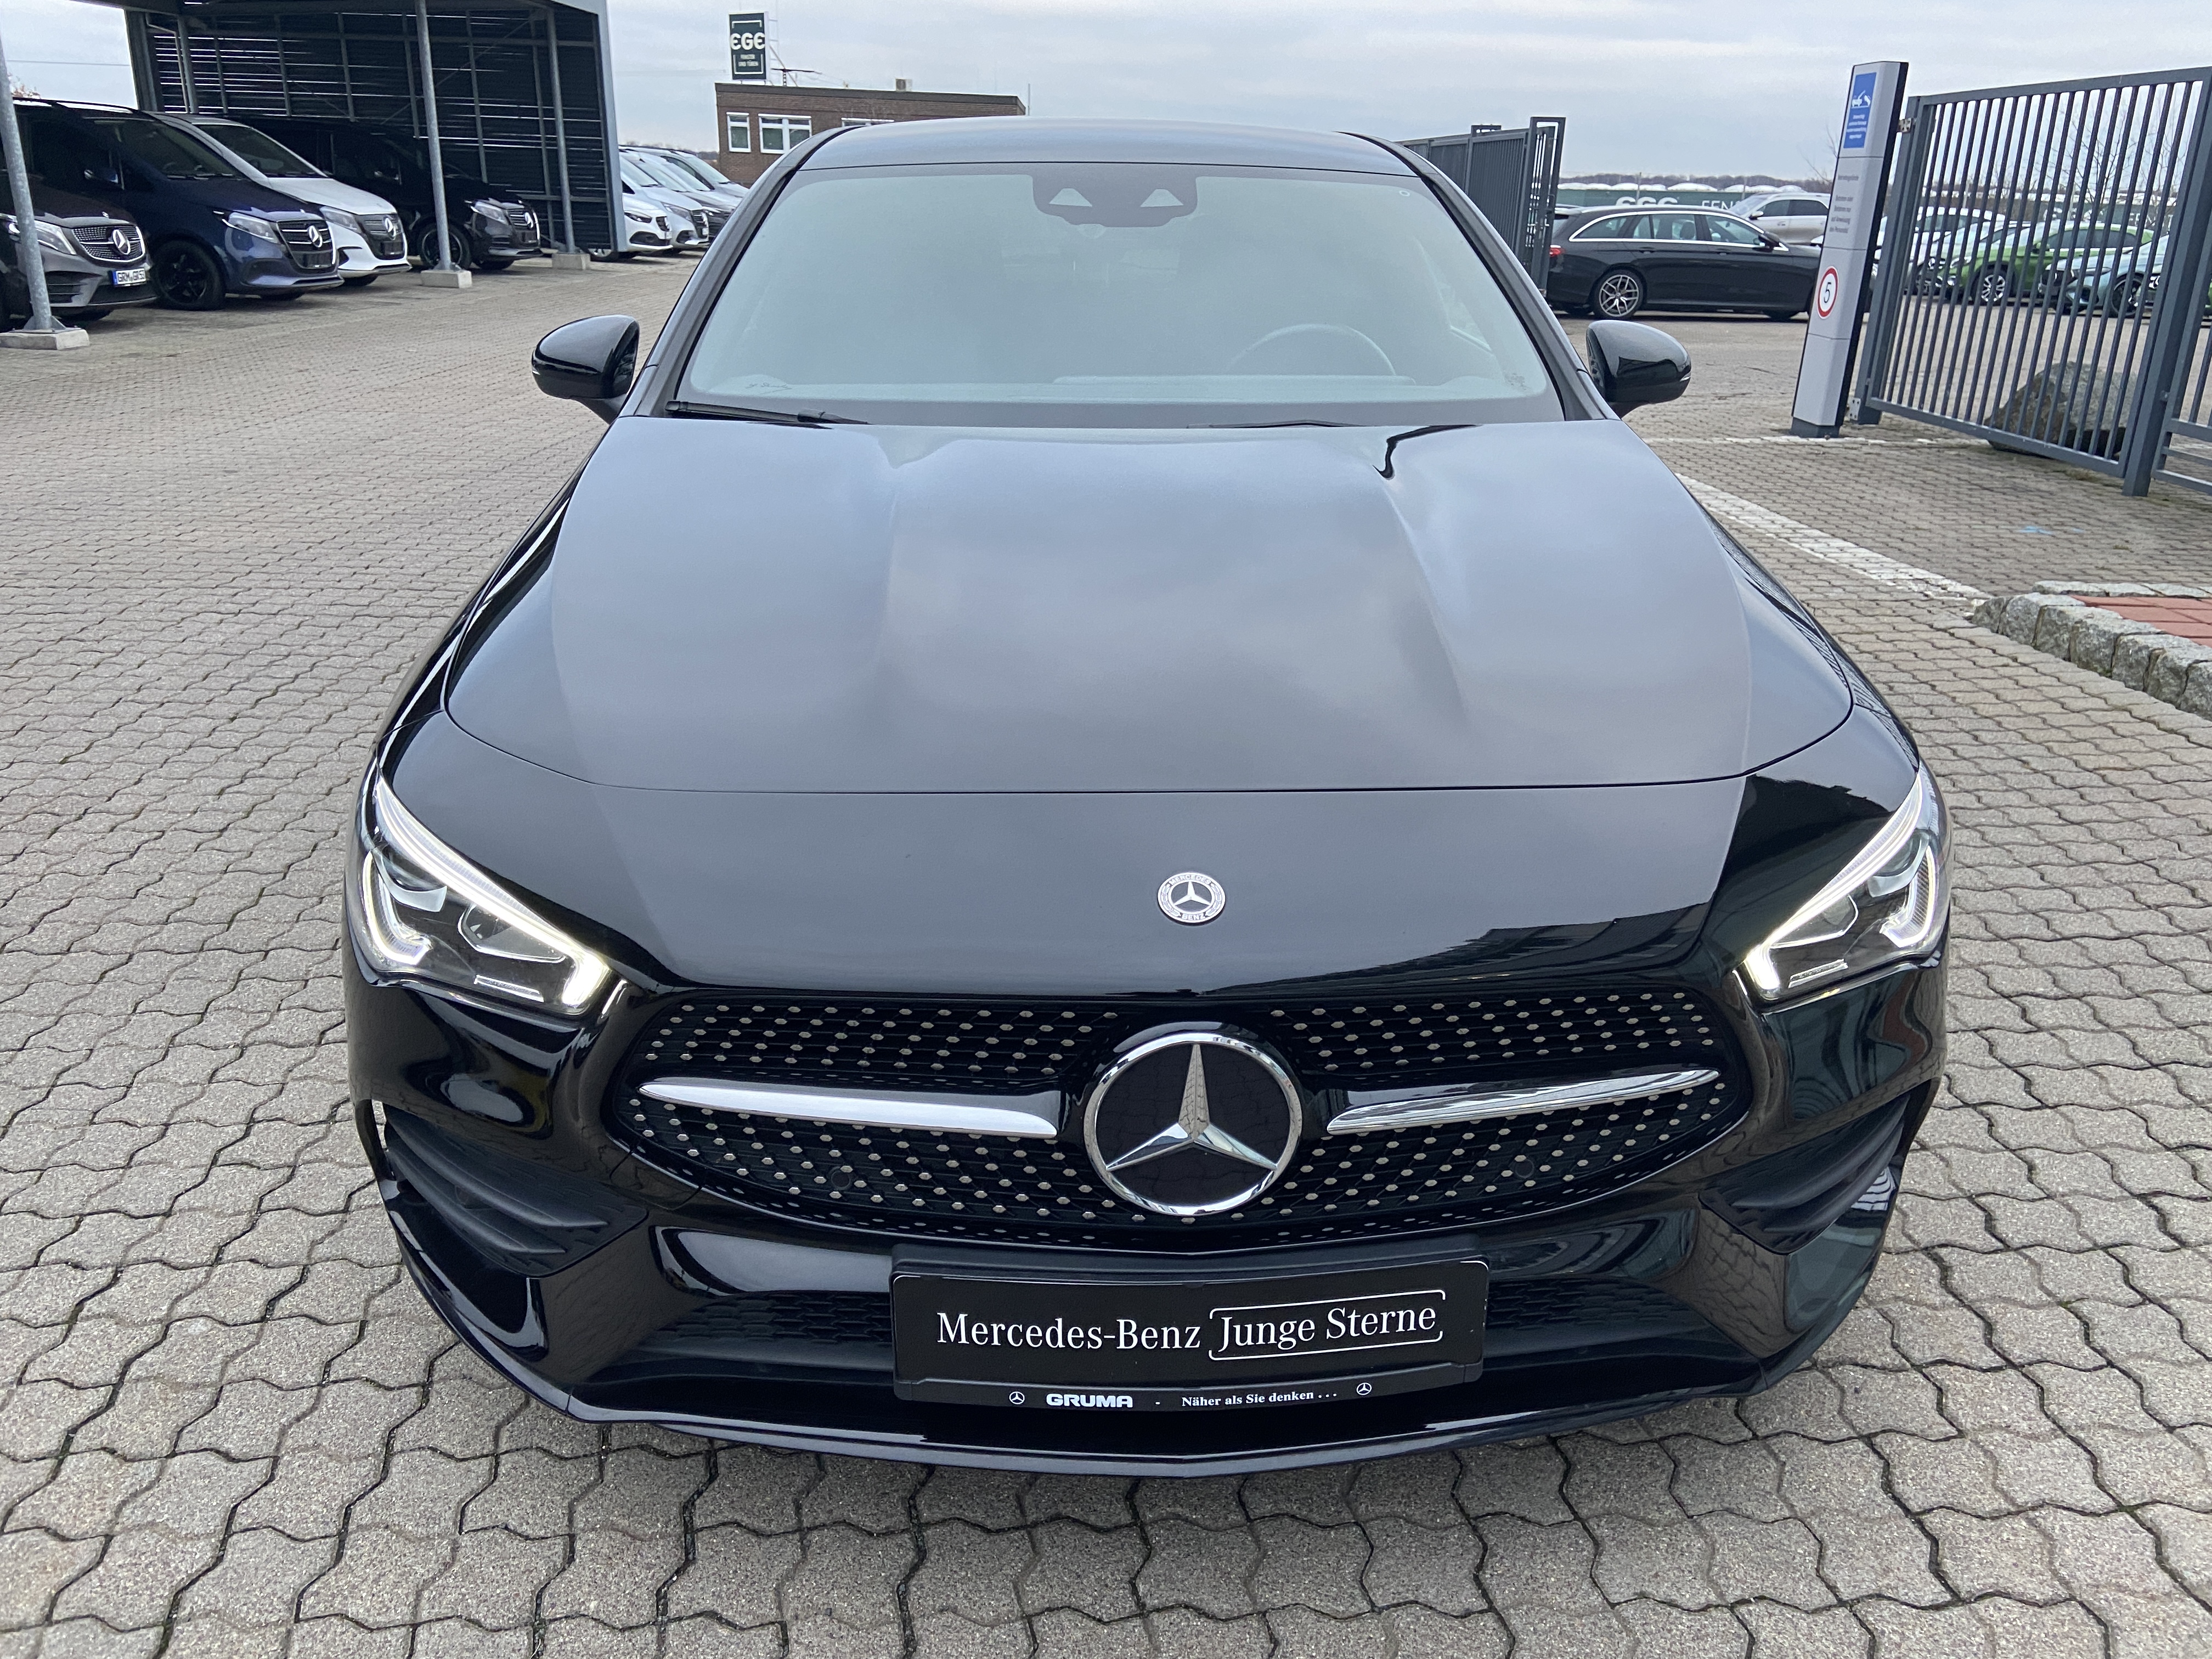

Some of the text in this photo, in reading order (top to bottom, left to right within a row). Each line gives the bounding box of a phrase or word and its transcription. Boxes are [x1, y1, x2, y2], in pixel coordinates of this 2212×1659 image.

[730, 32, 765, 50] EGE
[1824, 281, 1832, 304] 5
[1169, 874, 1211, 885] MERCEDES
[936, 1306, 1436, 1353] Mercedes-Benz Junge Sterne
[1046, 1393, 1133, 1408] GRUMA
[1181, 1396, 1222, 1407] Näher
[1224, 1395, 1243, 1406] als
[1245, 1393, 1266, 1404] Sie
[1268, 1391, 1314, 1403] denken
